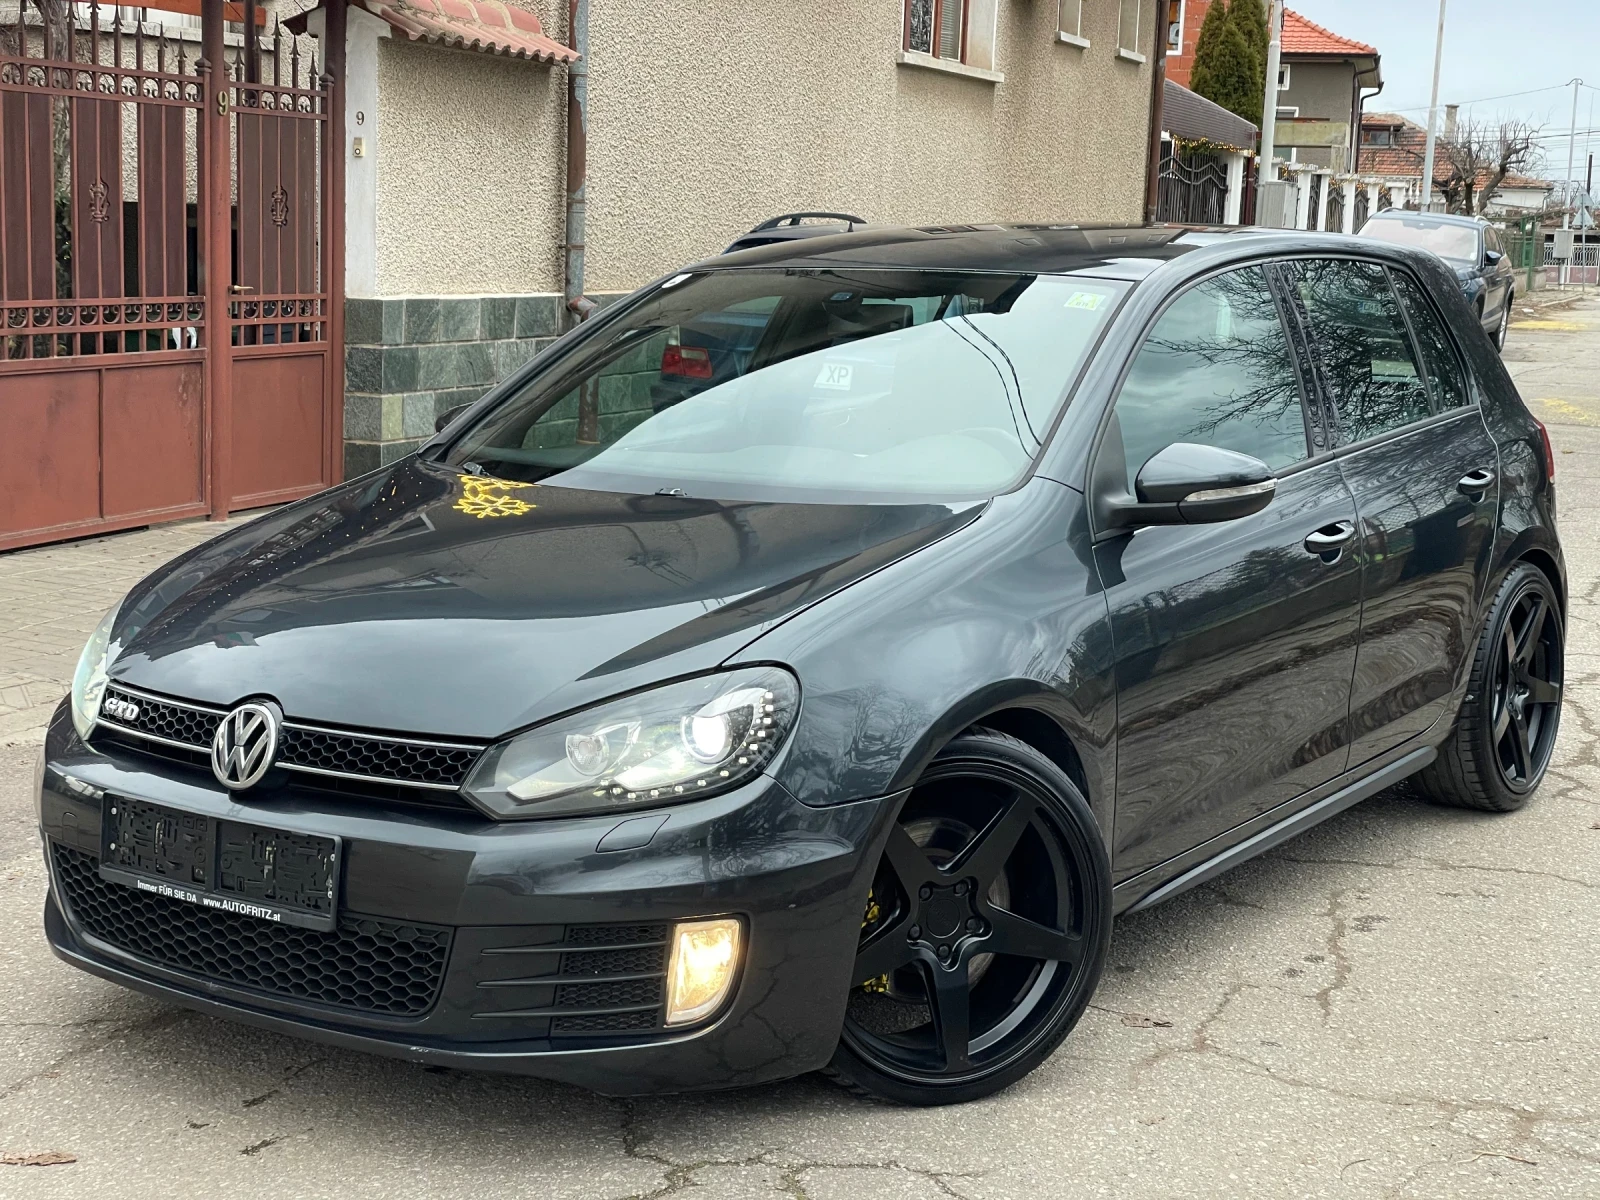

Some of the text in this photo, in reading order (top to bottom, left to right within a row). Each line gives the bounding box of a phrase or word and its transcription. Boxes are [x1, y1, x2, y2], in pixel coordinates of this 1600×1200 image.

[217, 91, 229, 116] 9
[355, 111, 365, 125] 9
[826, 365, 849, 384] XP
[104, 697, 140, 721] GTD
[212, 704, 278, 790] VW
[137, 879, 281, 922] Immer FÜR SIE DA www.AUTOFRITZ.at
